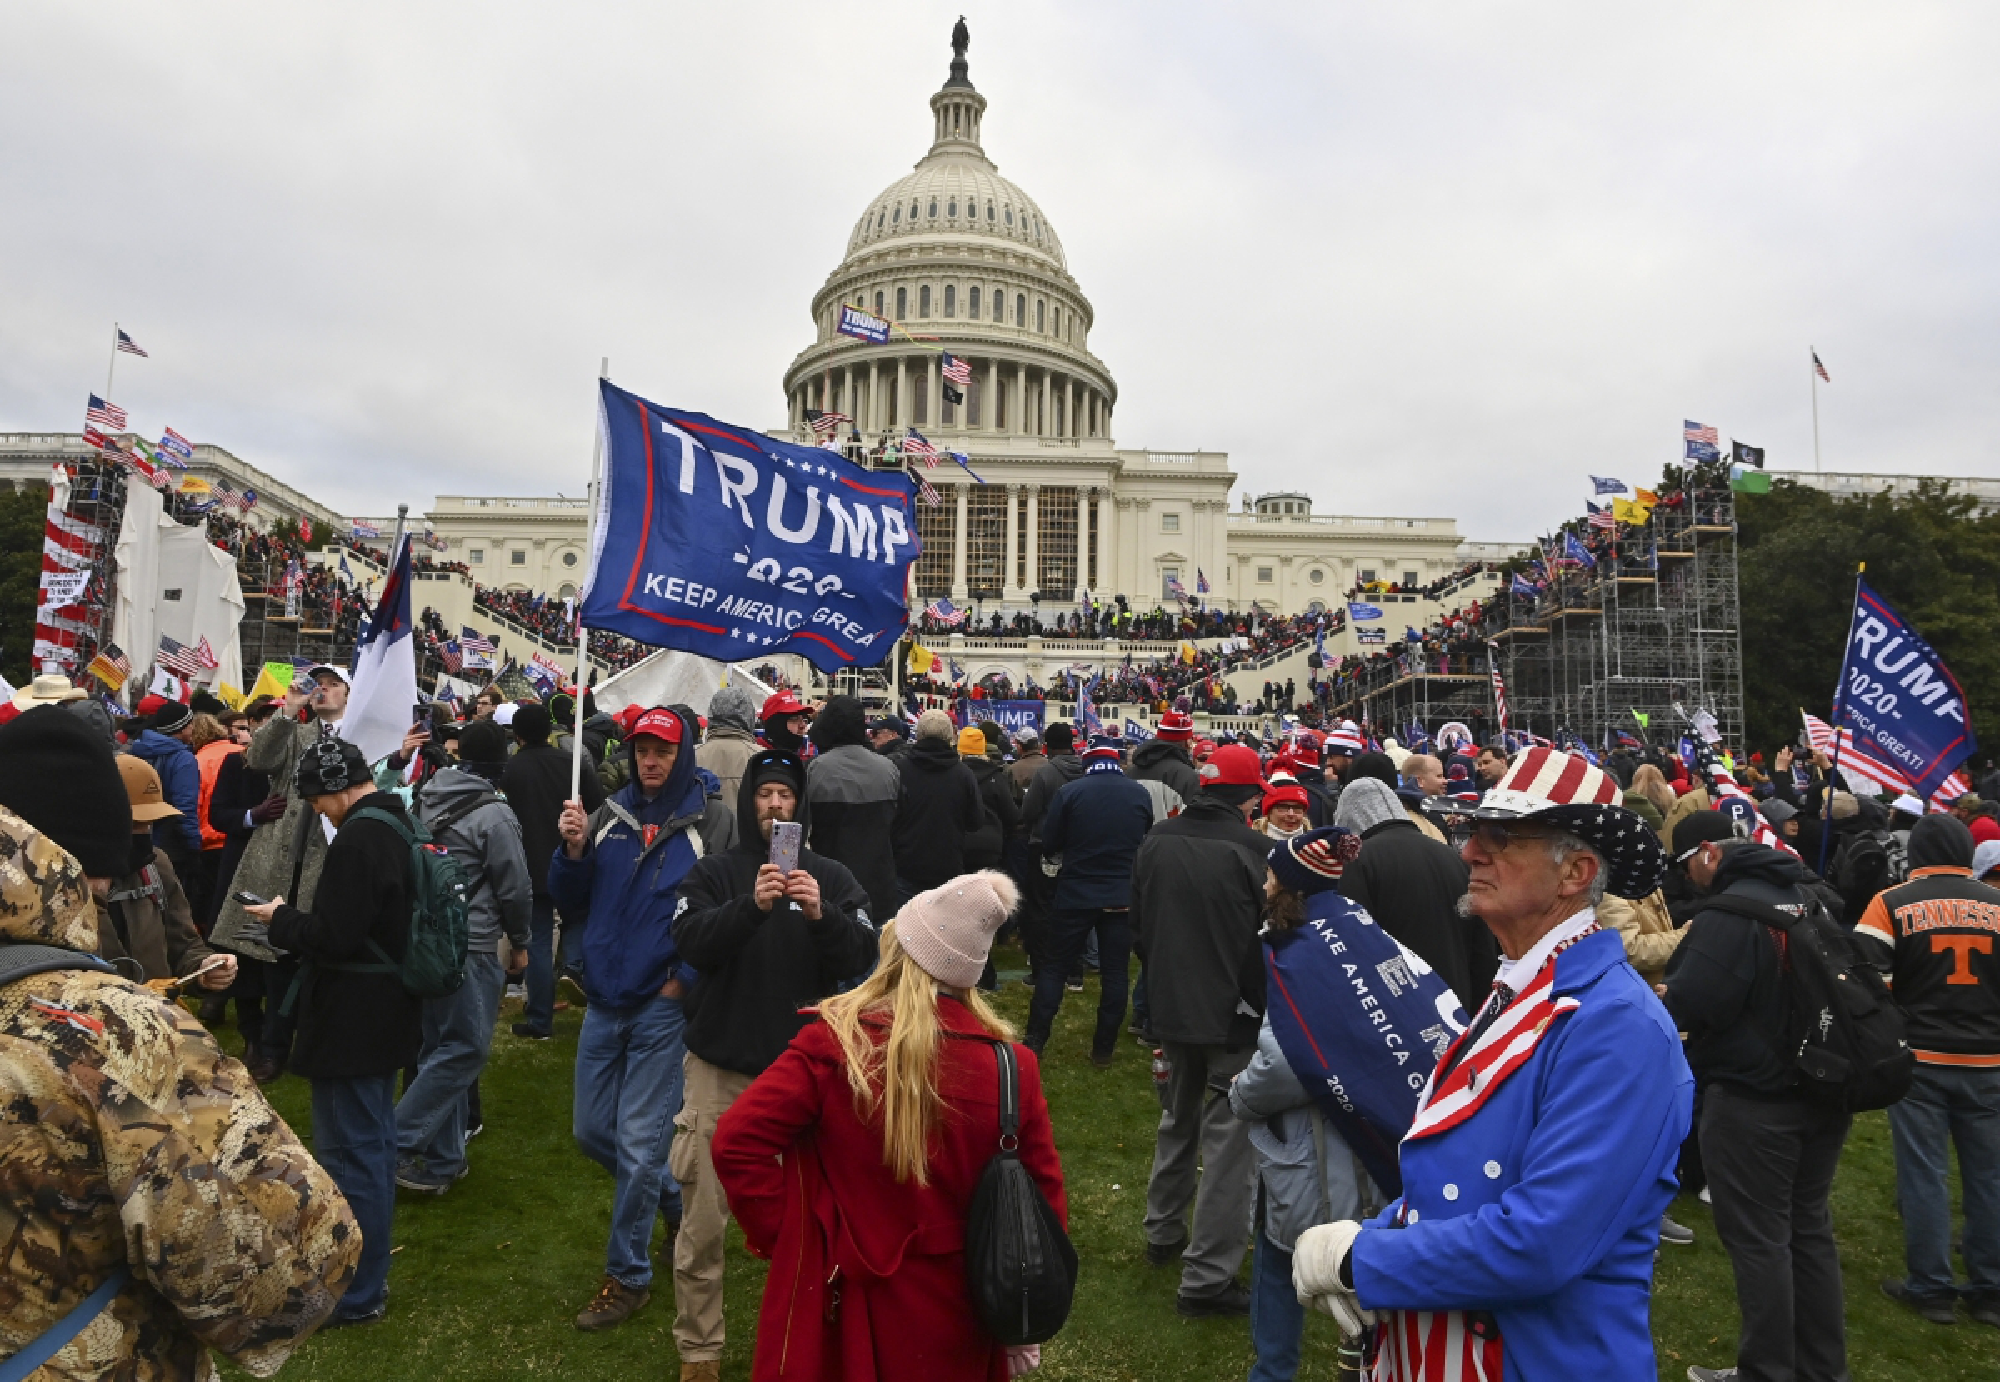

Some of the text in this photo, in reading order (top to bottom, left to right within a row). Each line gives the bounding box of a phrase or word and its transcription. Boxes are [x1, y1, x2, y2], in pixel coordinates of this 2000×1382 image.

[661, 421, 909, 565] TRUMP
[643, 572, 718, 609] KEEP
[715, 594, 808, 631] AMERIC
[1854, 606, 1964, 723] RUMP
[1894, 898, 2000, 937] TENNESS
[1930, 934, 1993, 985] T
[1310, 918, 1347, 956] AKE
[1342, 963, 1411, 1066] AMERICA
[1326, 1074, 1354, 1113] 2020
